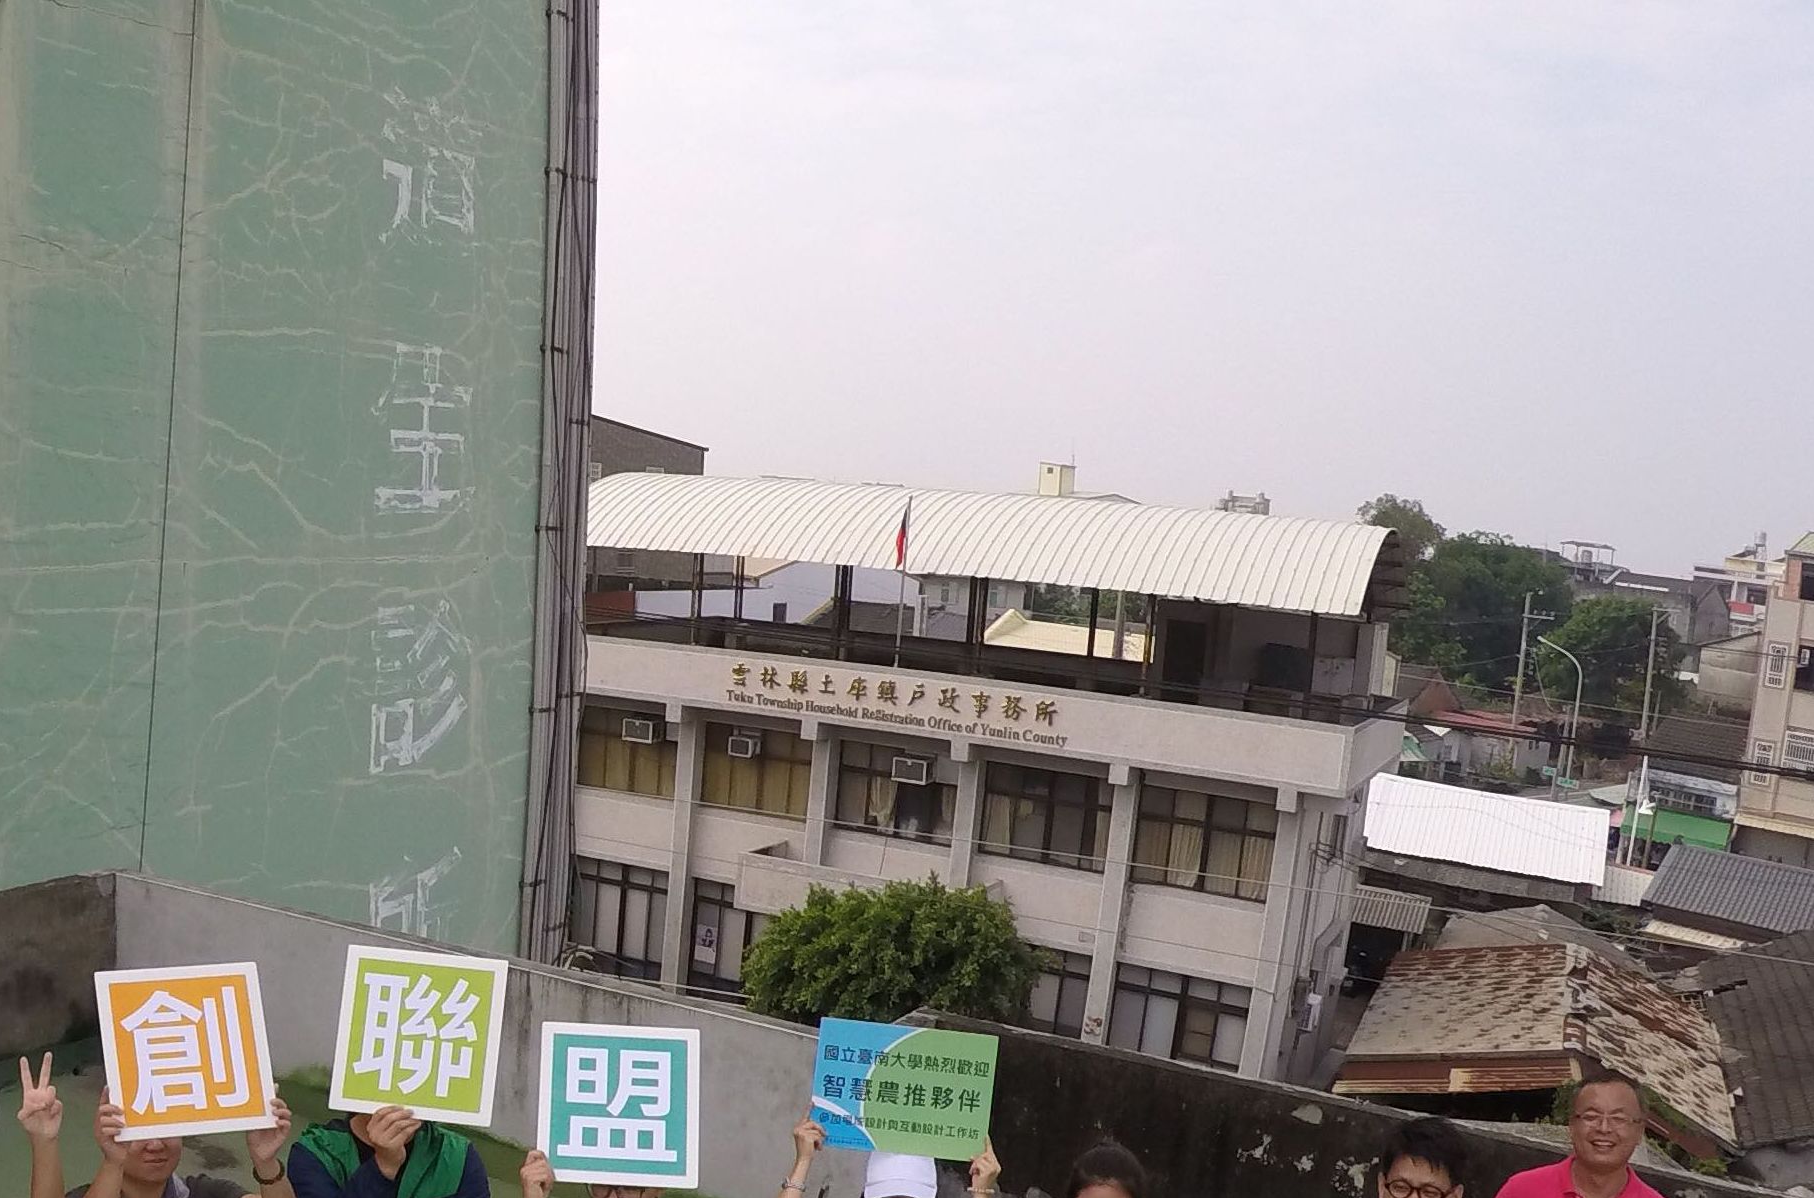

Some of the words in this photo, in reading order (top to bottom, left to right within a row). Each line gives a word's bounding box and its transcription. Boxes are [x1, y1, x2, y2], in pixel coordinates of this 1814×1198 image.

[726, 689, 754, 705] Tuku
[755, 692, 804, 714] Township
[805, 700, 859, 720] Household
[861, 706, 926, 728] Registration
[927, 715, 964, 734] Office
[965, 722, 979, 734] of
[980, 723, 1021, 742] Yunlin
[1022, 729, 1069, 749] County
[120, 985, 251, 1115] 創
[352, 972, 481, 1099] 聯
[824, 1044, 990, 1078] 國立臺南大學熱烈歡迎
[557, 1046, 678, 1163] 盟
[823, 1074, 981, 1113] 智慧農推夥伴
